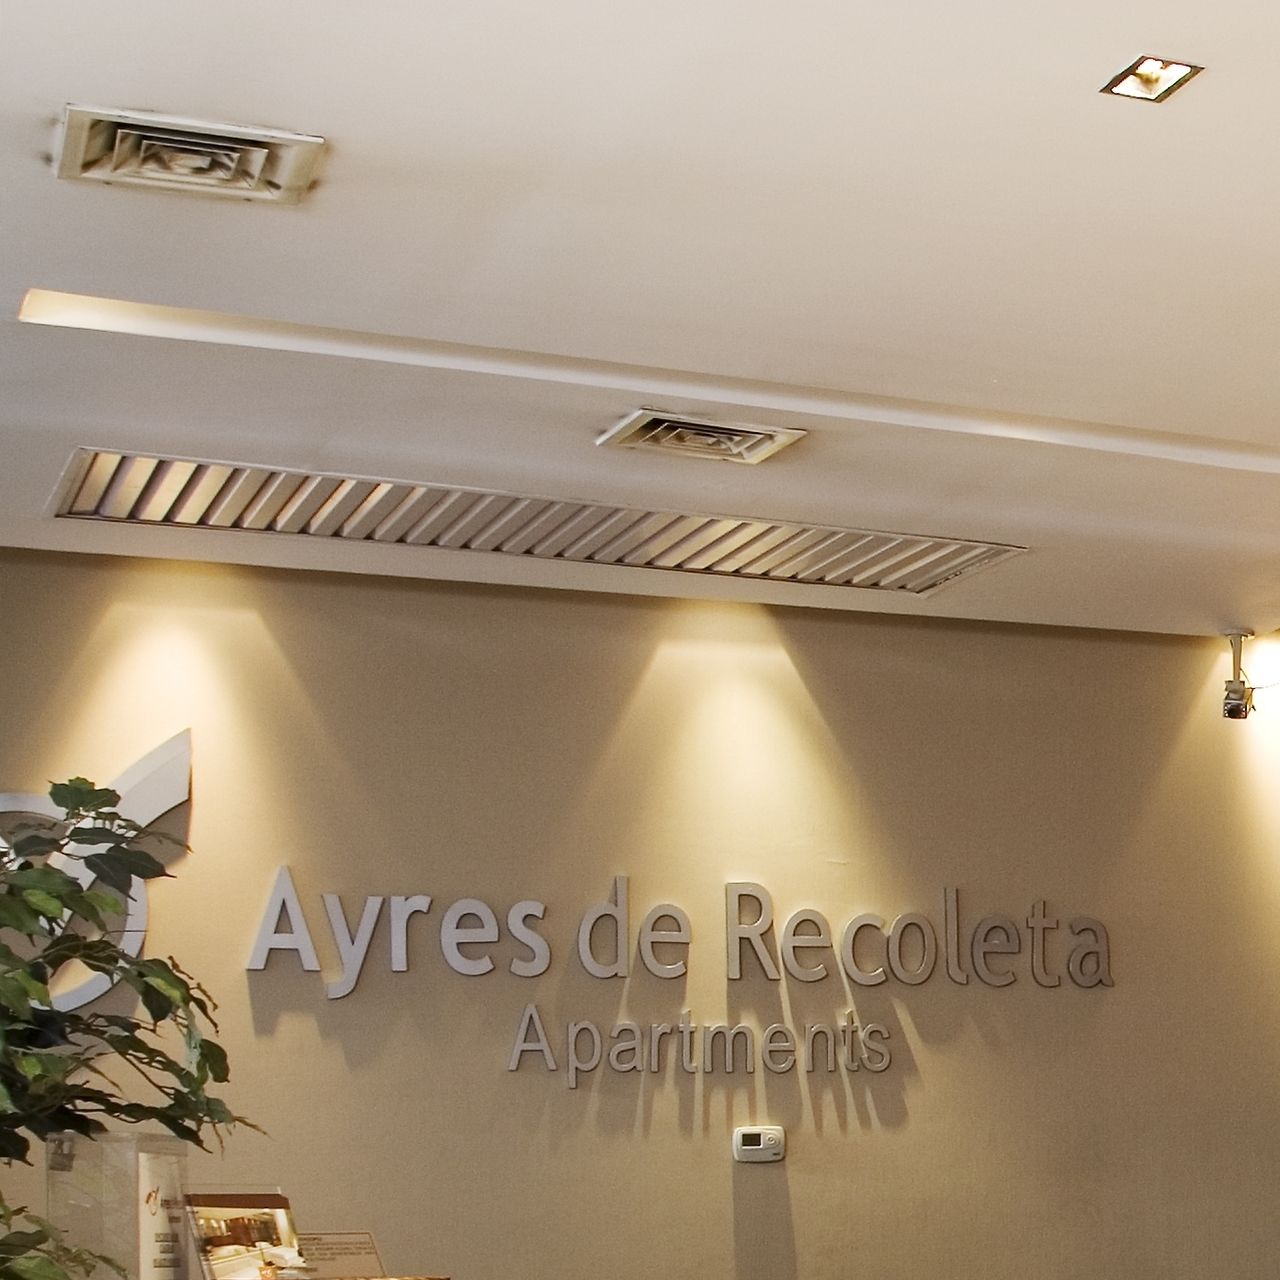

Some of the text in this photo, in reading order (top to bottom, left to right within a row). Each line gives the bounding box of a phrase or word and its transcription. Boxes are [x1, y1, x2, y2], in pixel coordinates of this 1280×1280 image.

[245, 864, 1115, 1000] Ayres de Recoleta
[507, 1003, 892, 1089] Apartments
